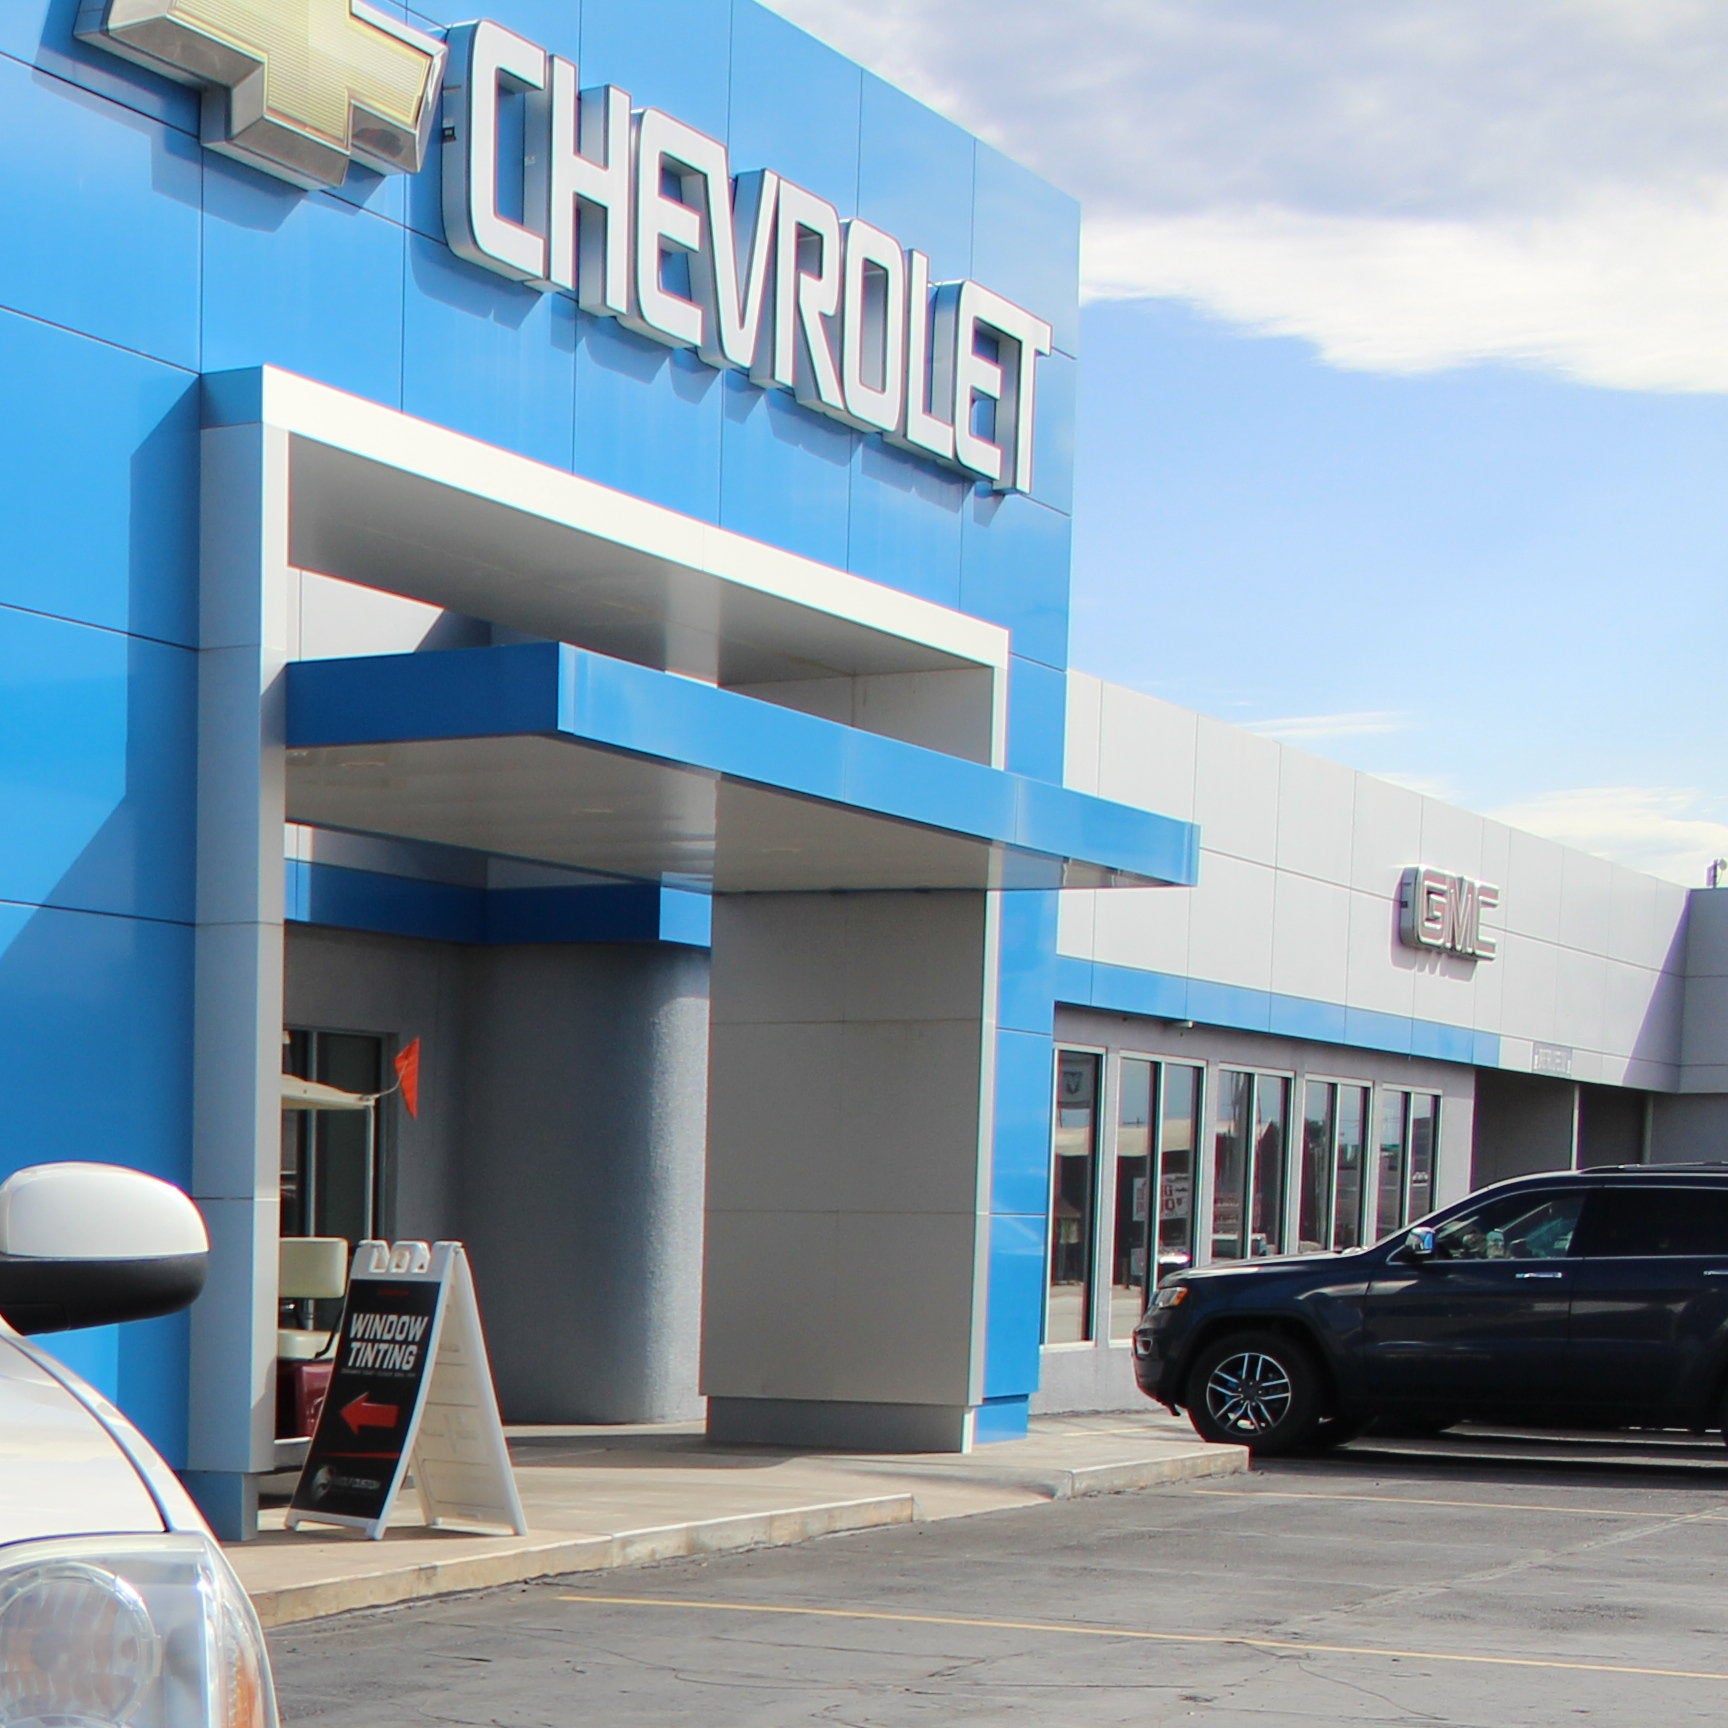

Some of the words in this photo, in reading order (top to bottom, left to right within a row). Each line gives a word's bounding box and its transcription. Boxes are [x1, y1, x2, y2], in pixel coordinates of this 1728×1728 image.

[444, 19, 1053, 494] CHEVROLET
[1399, 864, 1499, 960] GMC
[348, 1341, 418, 1370] TINTING
[350, 1313, 428, 1342] WINDOW
